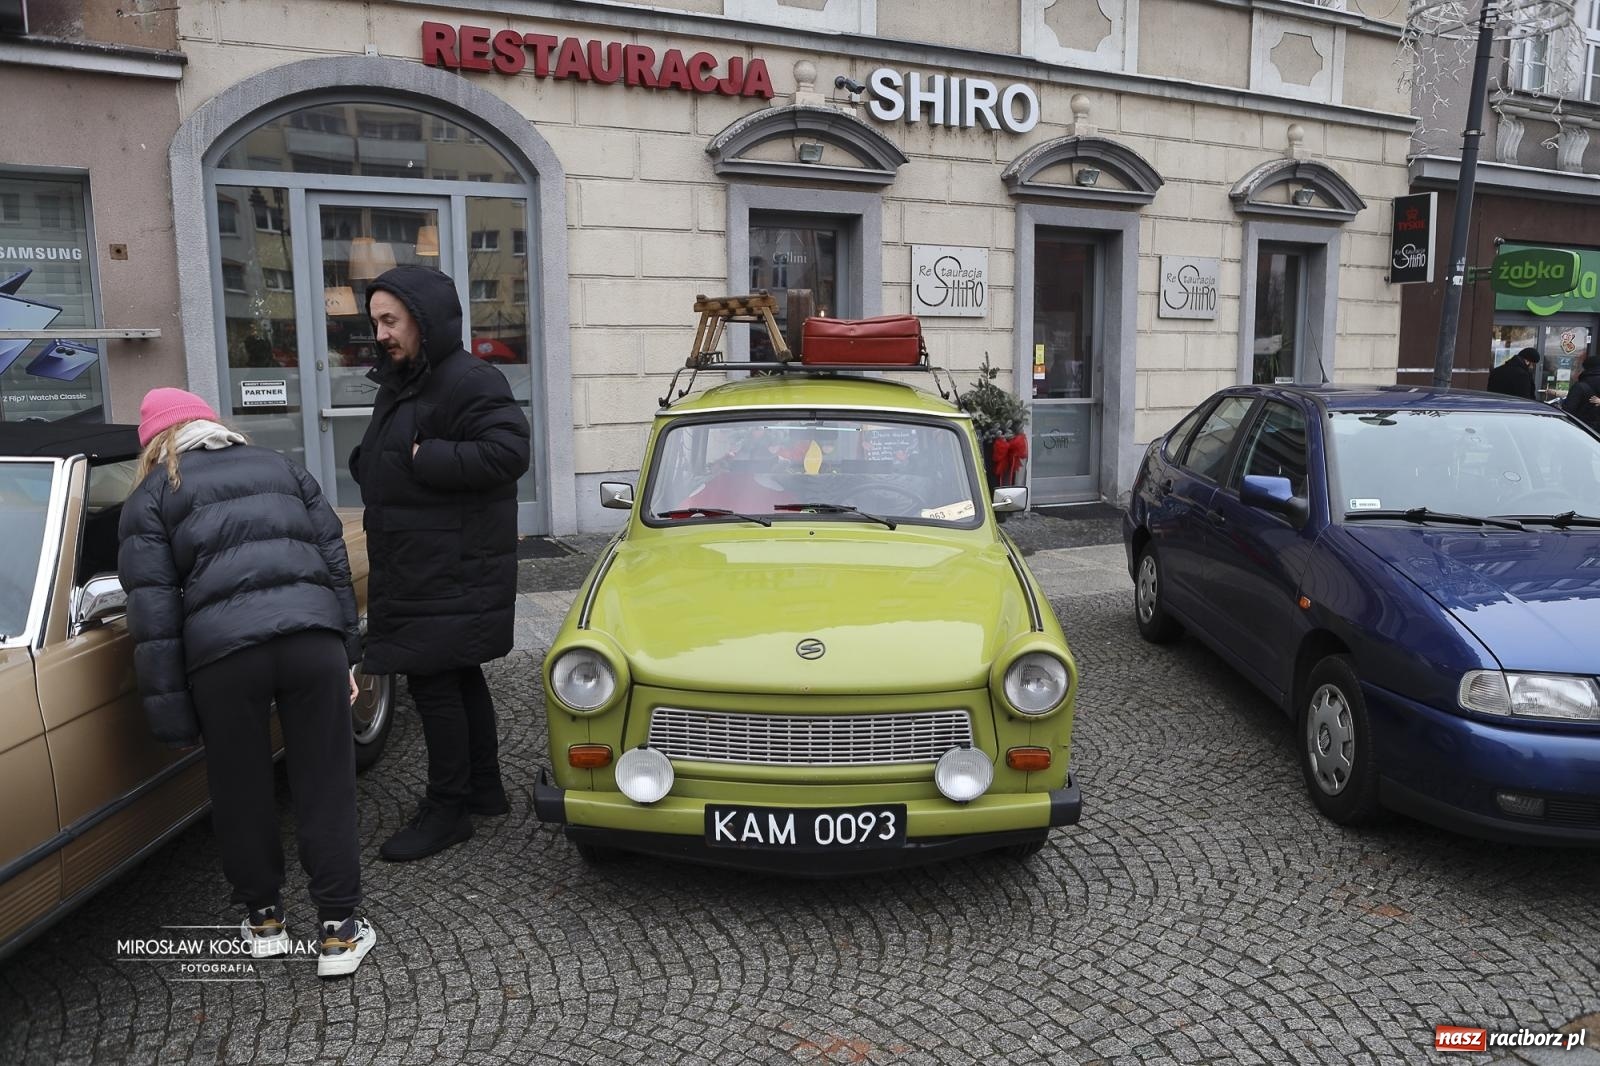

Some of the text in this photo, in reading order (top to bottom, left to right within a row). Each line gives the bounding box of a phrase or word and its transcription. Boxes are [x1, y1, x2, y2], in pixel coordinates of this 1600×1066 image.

[422, 21, 774, 100] RESTAURACJA
[865, 68, 1039, 134] SHIRO
[1499, 261, 1566, 280] żabka
[60, 392, 87, 400] Classic
[714, 811, 896, 845] KAM 0093
